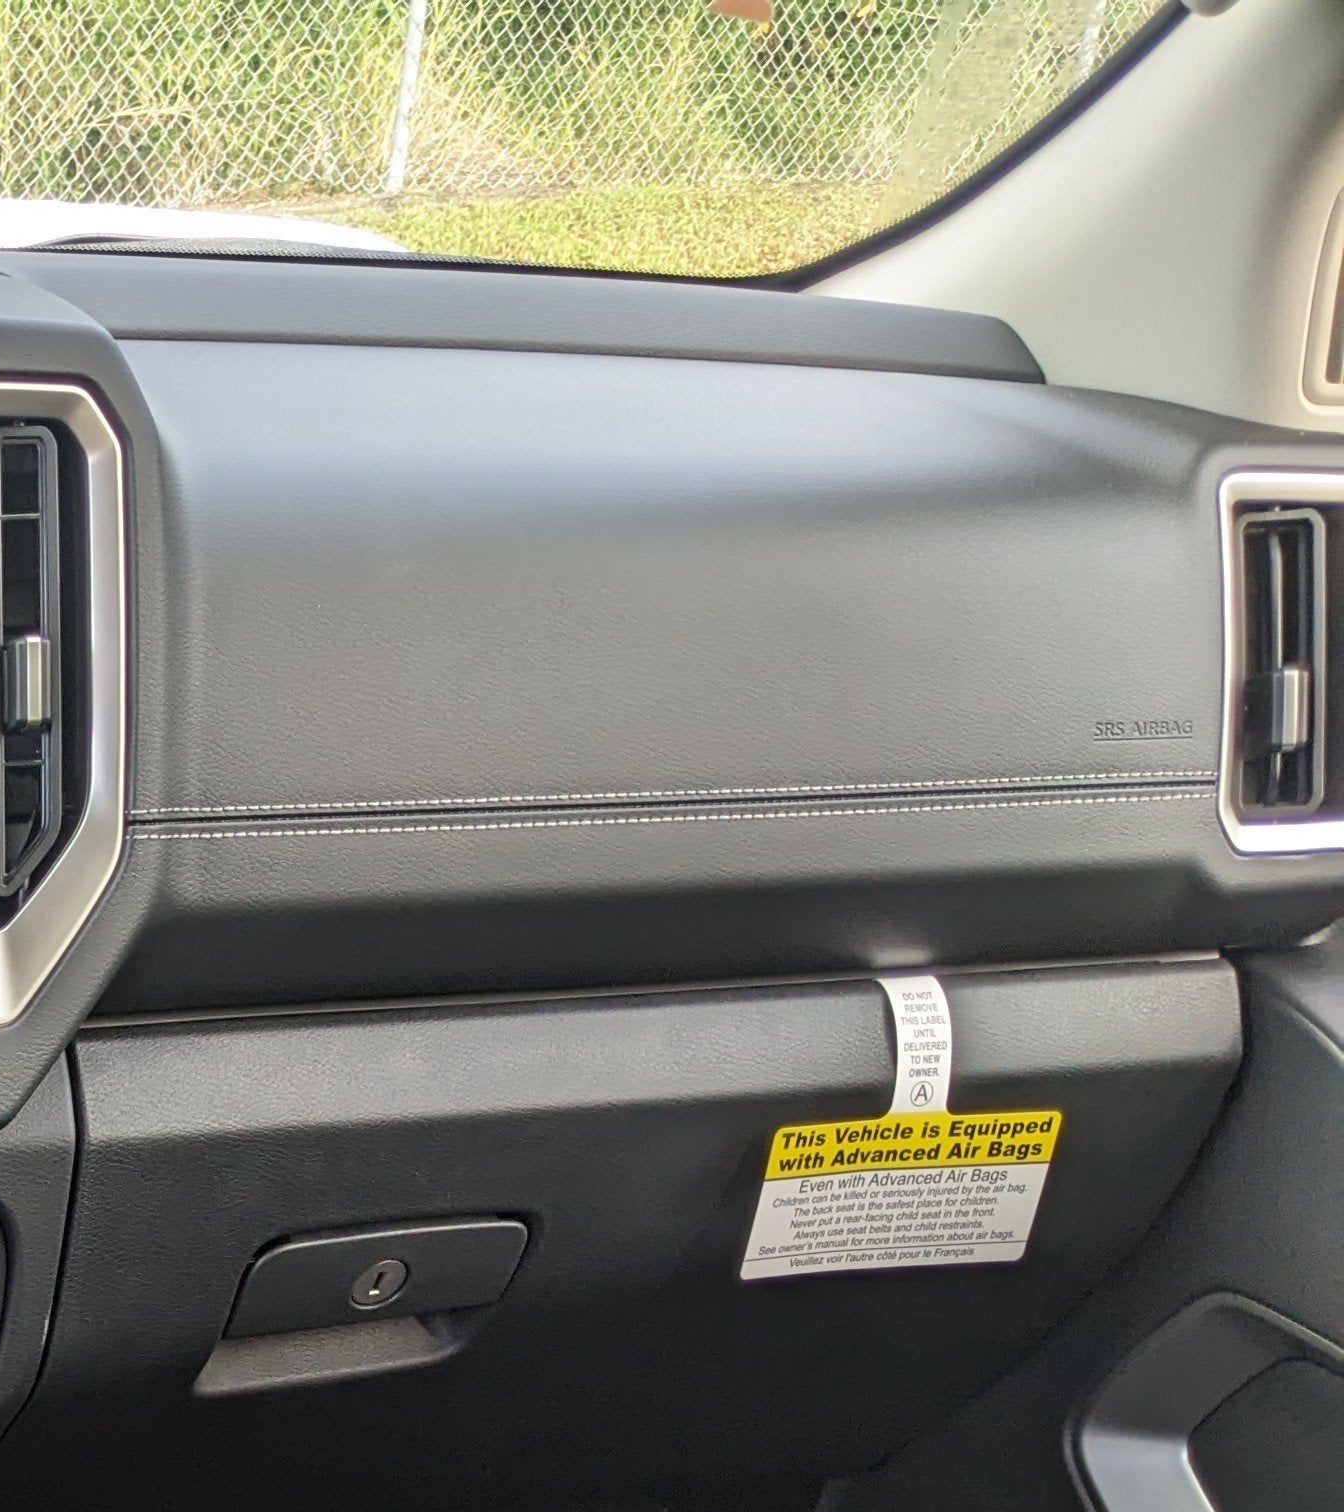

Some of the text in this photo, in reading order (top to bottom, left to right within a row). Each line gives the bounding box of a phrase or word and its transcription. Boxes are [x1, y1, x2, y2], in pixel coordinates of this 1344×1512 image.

[782, 1117, 1054, 1150] This Vehicle is Equipped
[779, 1141, 1043, 1172] with Advanced Air Bags
[799, 1168, 1008, 1194] Even with Advanced Air Bags
